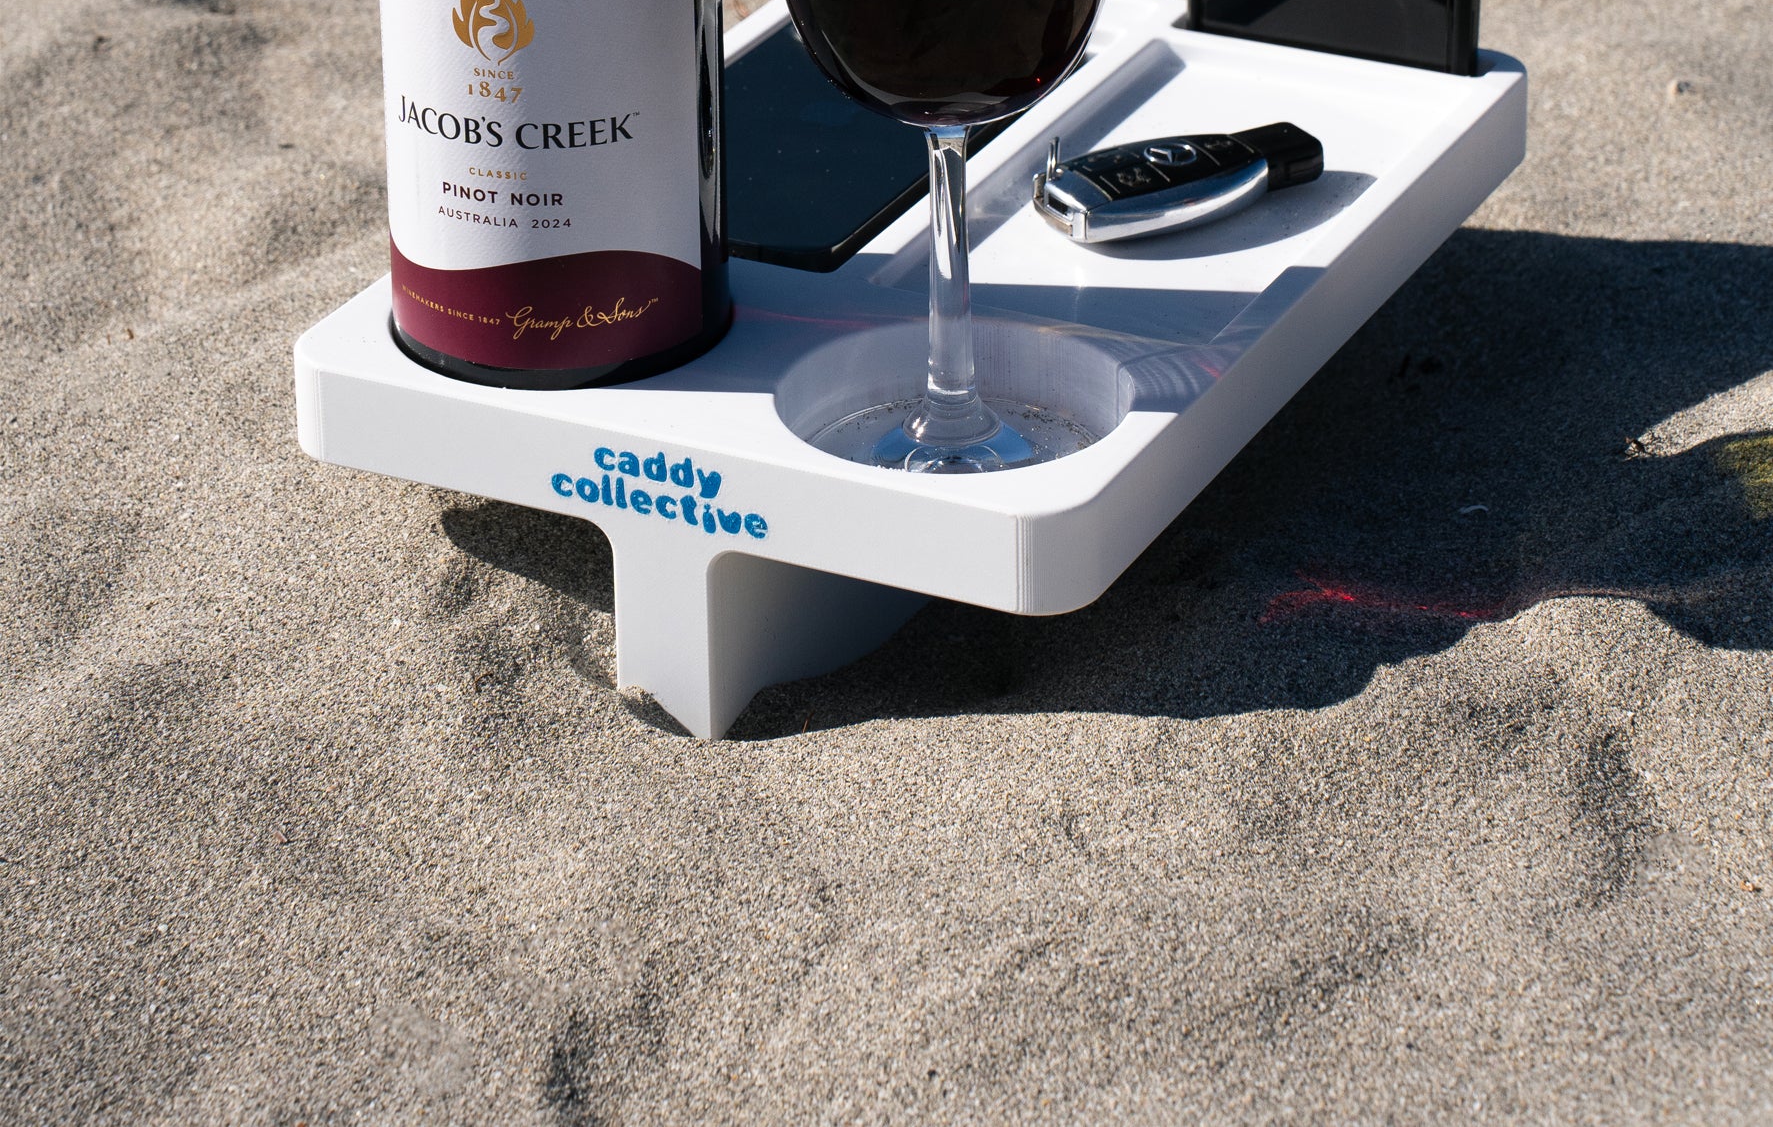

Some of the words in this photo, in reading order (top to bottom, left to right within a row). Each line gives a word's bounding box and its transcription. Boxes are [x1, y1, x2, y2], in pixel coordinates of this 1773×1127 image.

[473, 67, 514, 80] SINCE
[467, 81, 523, 103] 1847
[398, 95, 503, 148] JACOB'S
[469, 167, 528, 181] CLASSIC
[442, 181, 498, 204] PINOT
[511, 193, 563, 206] NOIR
[438, 205, 518, 228] AUSTRALIA
[531, 218, 572, 229] 2024
[402, 284, 444, 313] WINEMAKERS
[447, 308, 474, 321] SINCE
[478, 316, 500, 326] 1847
[505, 306, 573, 341] Gramp
[593, 446, 722, 499] caddy
[551, 472, 768, 539] collective
